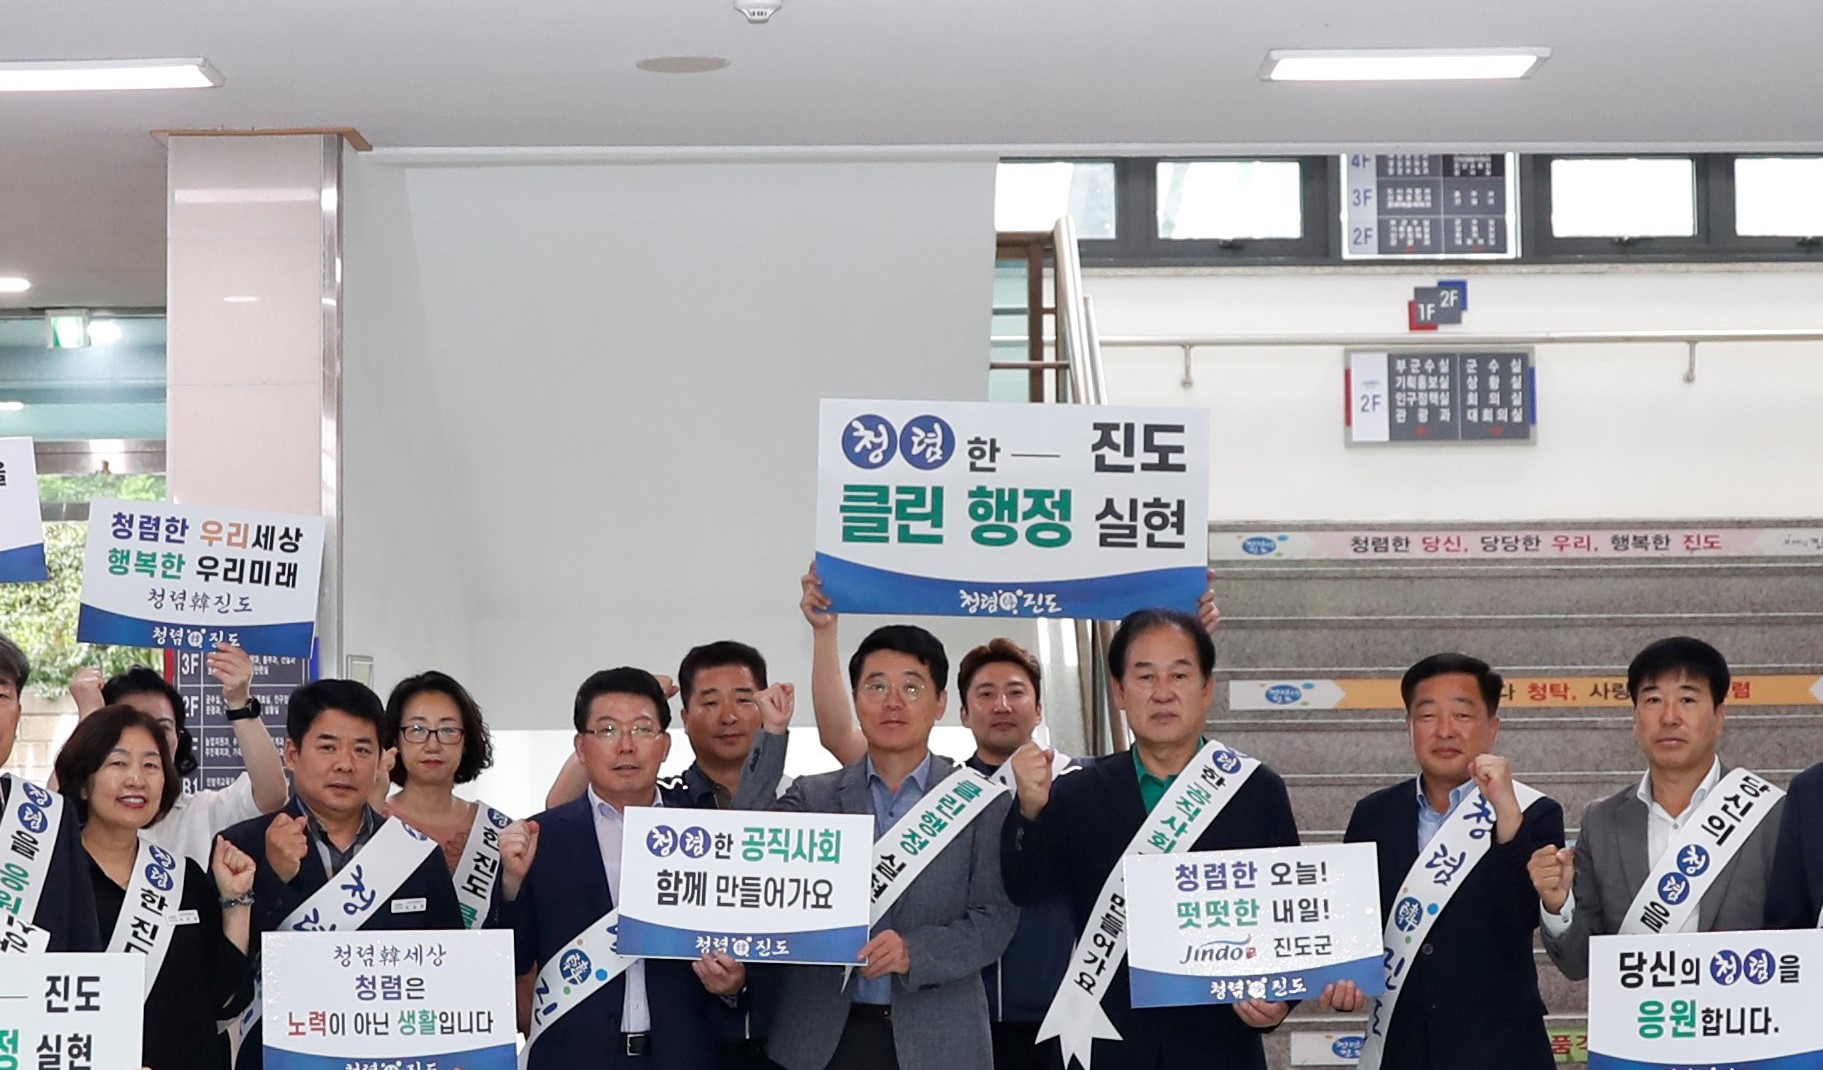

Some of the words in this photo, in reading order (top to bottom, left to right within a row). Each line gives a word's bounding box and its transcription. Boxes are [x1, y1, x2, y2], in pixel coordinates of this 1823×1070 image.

[1353, 189, 1372, 207] 3F
[1353, 228, 1374, 245] 2F
[1418, 304, 1436, 320] 1F
[1440, 290, 1458, 307] 2F
[1360, 394, 1381, 413] 2F
[1091, 421, 1187, 473] 진도
[839, 483, 945, 545] 클린
[967, 485, 1073, 548] 행정
[1095, 497, 1186, 549] 실현
[111, 511, 189, 545] 청렴한
[200, 519, 303, 553] 우리세상
[1350, 535, 1411, 553] 청렴한
[1480, 535, 1541, 552] 당당한
[1610, 534, 1671, 552] 행복한
[1682, 533, 1722, 551] 진도
[108, 548, 185, 579] 행복한
[196, 555, 298, 588] 우리미래
[182, 653, 199, 674] 3F
[741, 826, 841, 865] 공직사회
[656, 869, 708, 908] 함께
[716, 873, 834, 910] 만들어가요
[1175, 861, 1258, 893] 청렴한
[1270, 860, 1328, 887] 오늘!
[1176, 899, 1260, 930] 떳떳한
[1273, 896, 1330, 924] 내일!
[1179, 938, 1246, 966] Jindo
[1273, 934, 1333, 959] 진도군
[1620, 950, 1701, 989] 당신의
[44, 974, 102, 1014] 진도
[354, 973, 425, 1002] 청렴은
[287, 1009, 347, 1037] 노력이
[353, 1011, 390, 1037] 아닌
[397, 1008, 494, 1036] 생활입니다
[1637, 999, 1781, 1039] 응원합니다.
